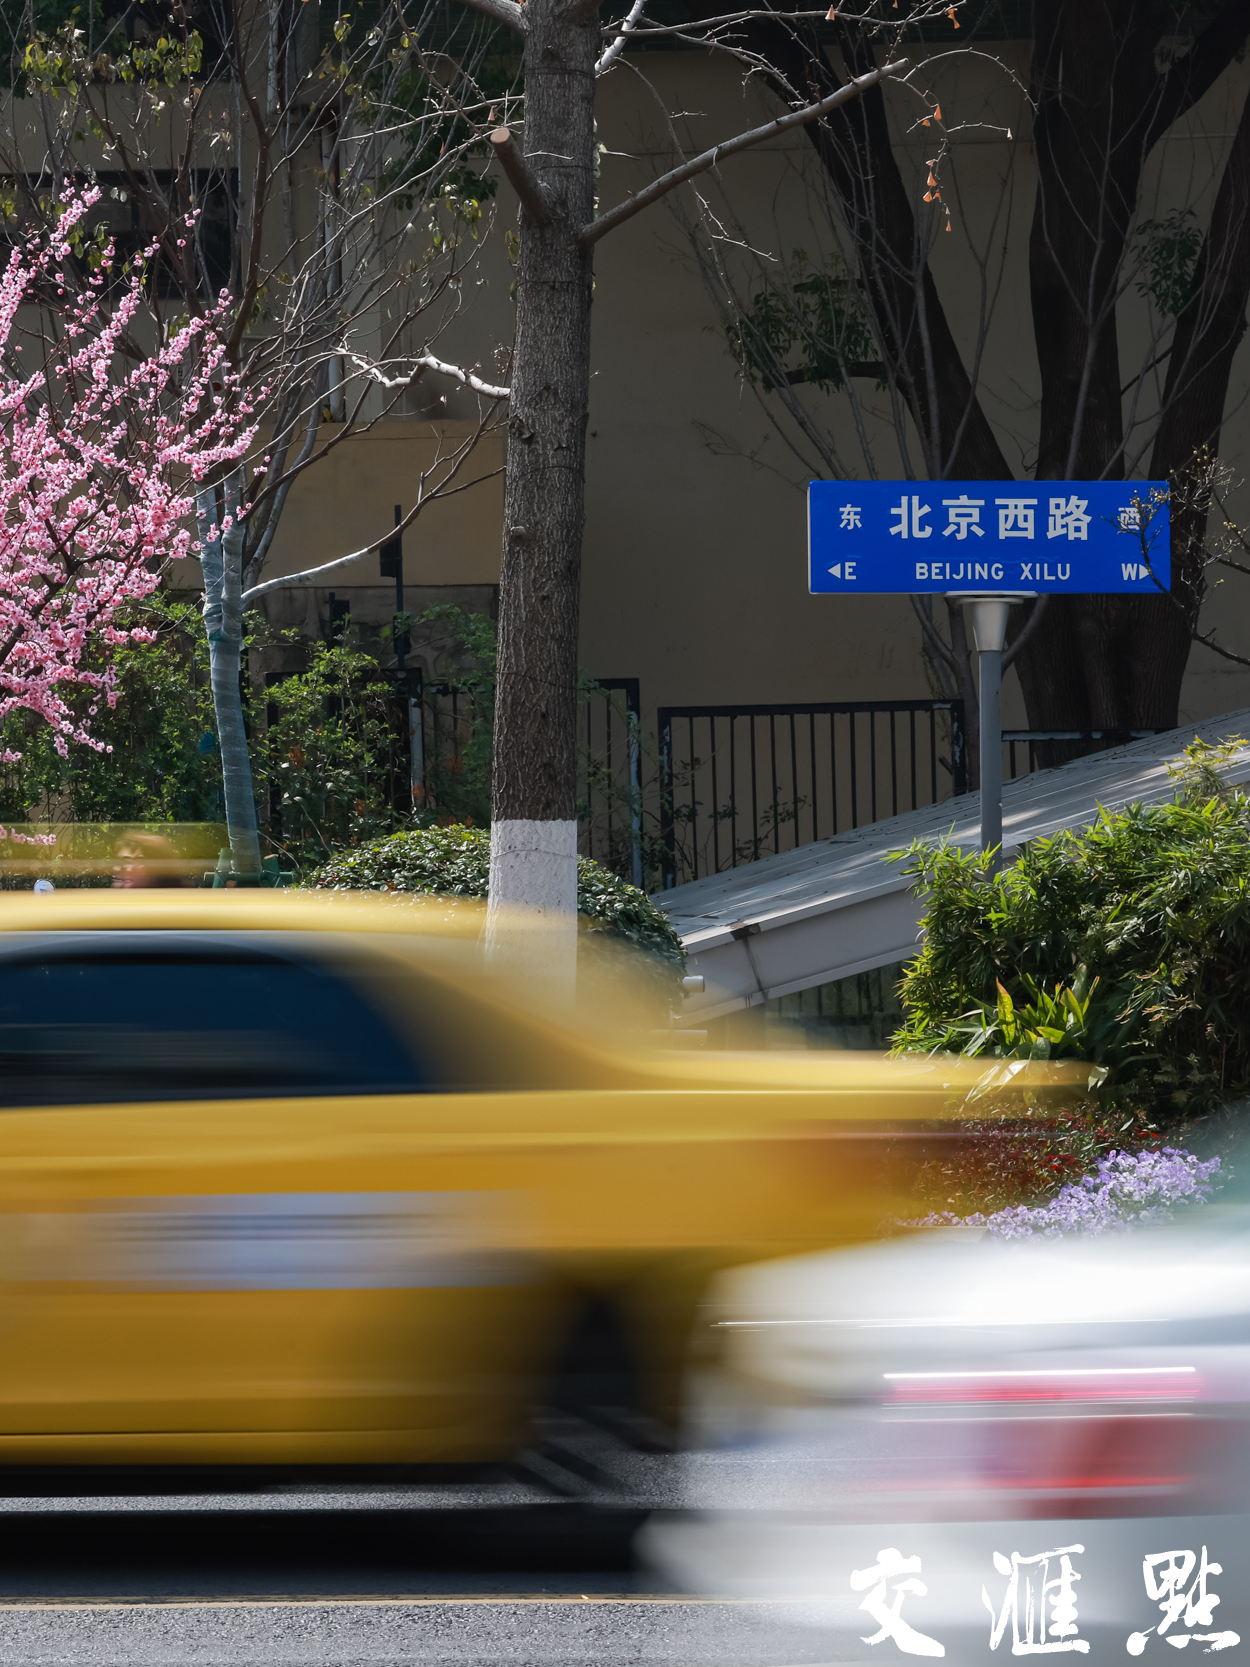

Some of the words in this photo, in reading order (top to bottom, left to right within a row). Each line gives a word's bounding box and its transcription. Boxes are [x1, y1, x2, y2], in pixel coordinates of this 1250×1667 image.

[839, 504, 862, 530] 东
[889, 495, 1092, 540] 北京西路
[844, 562, 857, 580] E
[915, 563, 1004, 580] BEIJING
[1020, 563, 1071, 580] XILU
[1121, 563, 1138, 580] W
